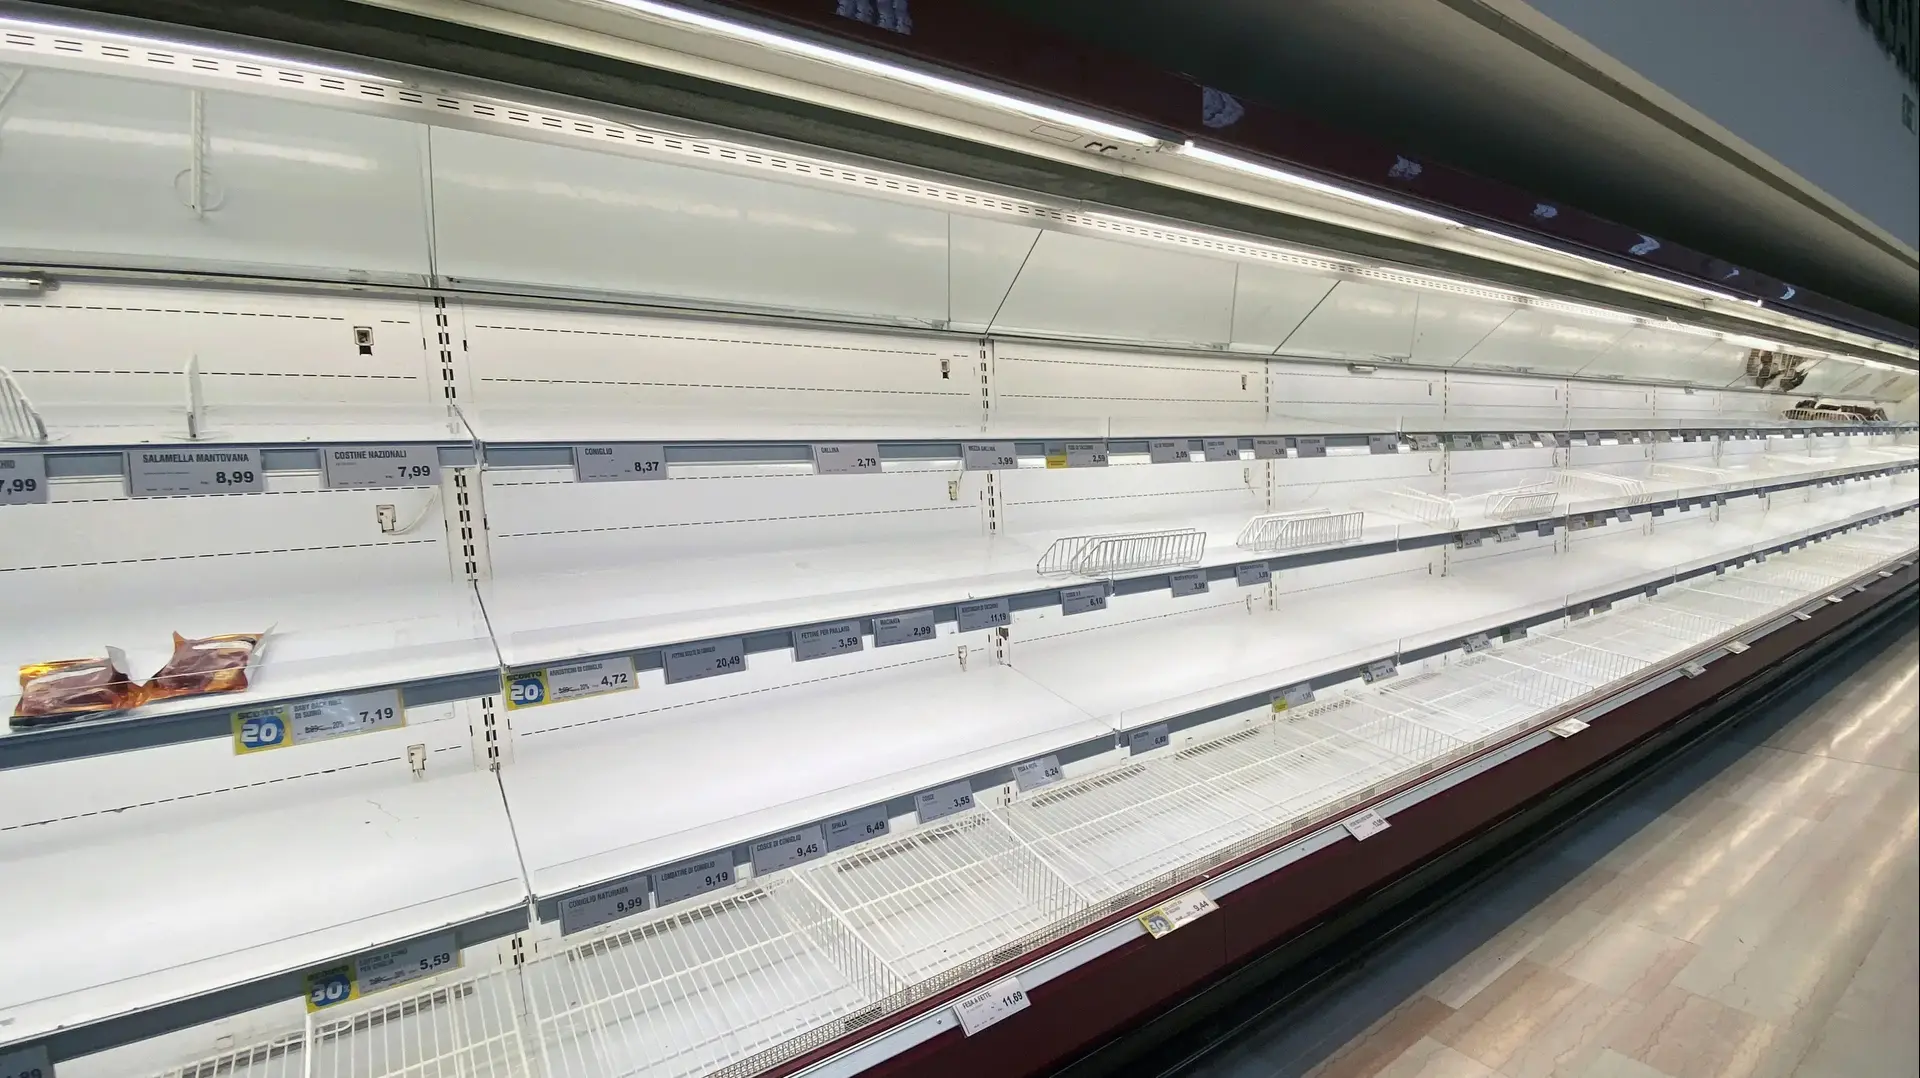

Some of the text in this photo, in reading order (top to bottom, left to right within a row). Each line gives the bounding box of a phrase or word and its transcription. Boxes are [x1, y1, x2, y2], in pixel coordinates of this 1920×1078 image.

[143, 453, 250, 463] SALAMELLA MANTOVANA
[334, 450, 407, 460] COSTINE NAZIONALI
[998, 456, 1013, 465] 3,99
[634, 461, 660, 473] 8,37
[857, 458, 877, 468] 2,79
[216, 471, 254, 486] 8,99
[398, 464, 431, 480] 7,99
[801, 630, 819, 640] FETTINE
[820, 628, 828, 636] PER
[913, 626, 931, 637] 2,99
[838, 637, 858, 649] 3,59
[716, 656, 740, 668] 20,49
[506, 670, 542, 682] SCONTO
[600, 673, 628, 688] 4,72
[359, 708, 394, 724] 7,19
[332, 721, 344, 729] 20%
[954, 795, 970, 808] 3,55
[866, 820, 884, 834] 6,49
[756, 842, 773, 852] COSCE
[779, 834, 802, 846] CONIGLIO
[796, 843, 818, 857] 9,45
[661, 868, 688, 882] LOMBATINE
[694, 861, 716, 872] CONIGLIO
[705, 872, 729, 886] 9,19
[568, 886, 629, 909] CONIGLIO NATURAMA
[616, 896, 642, 912] 9,99
[1192, 900, 1209, 912] 9,44
[420, 952, 450, 970] 5,59
[962, 998, 974, 1010] FESA
[978, 991, 992, 1002] FETTE
[1002, 990, 1023, 1008] 11,69
